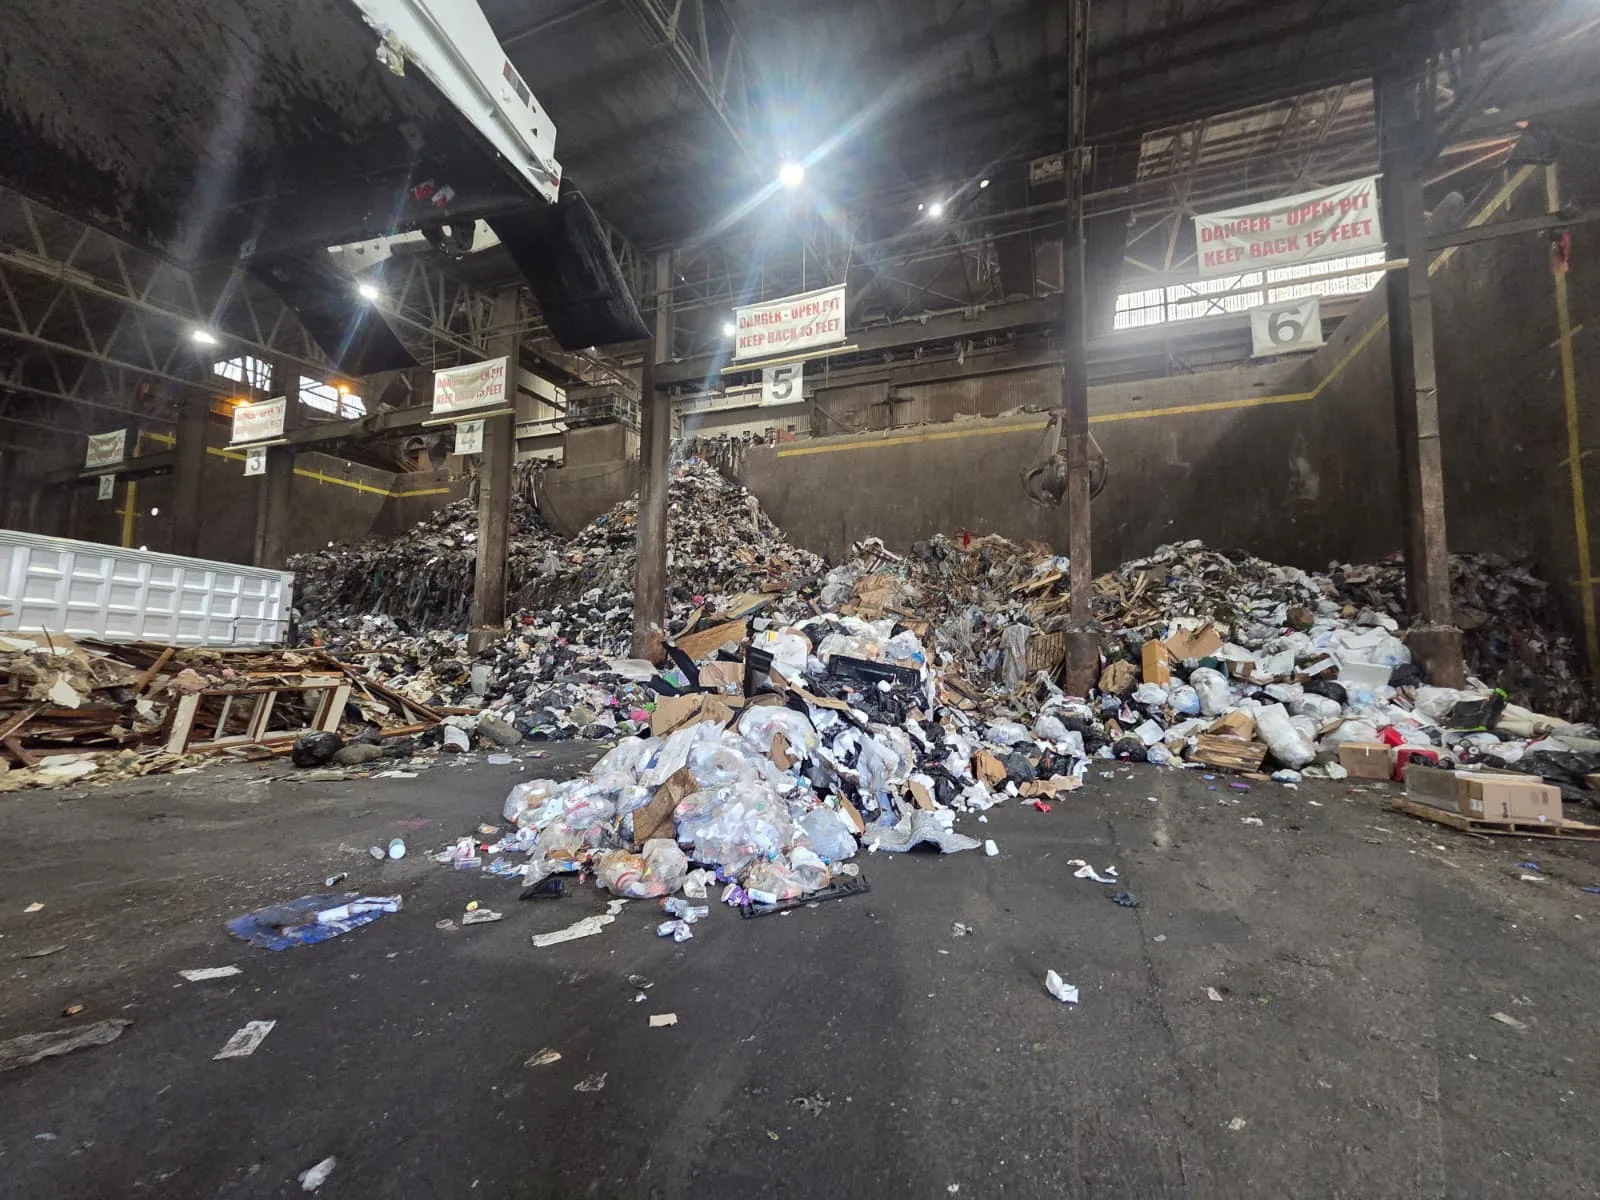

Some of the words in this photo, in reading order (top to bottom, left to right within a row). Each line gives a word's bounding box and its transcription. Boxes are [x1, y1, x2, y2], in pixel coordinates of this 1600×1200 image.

[1201, 217, 1271, 243] DANGER
[1286, 200, 1334, 227] OPEN
[1340, 192, 1370, 216] PIT
[1204, 245, 1245, 267] KEEP
[1249, 236, 1301, 258] BACK
[1304, 229, 1324, 248] 15
[1331, 219, 1372, 243] FEET
[740, 312, 782, 329] DANGER
[791, 302, 820, 320] OPEN
[1267, 308, 1304, 346] 6
[740, 333, 766, 348] KEEP
[767, 327, 797, 343] BACK
[815, 318, 841, 335] FEET
[772, 367, 793, 400] 5
[461, 424, 476, 450] 4
[250, 450, 261, 471] 3
[101, 477, 112, 497] 2
